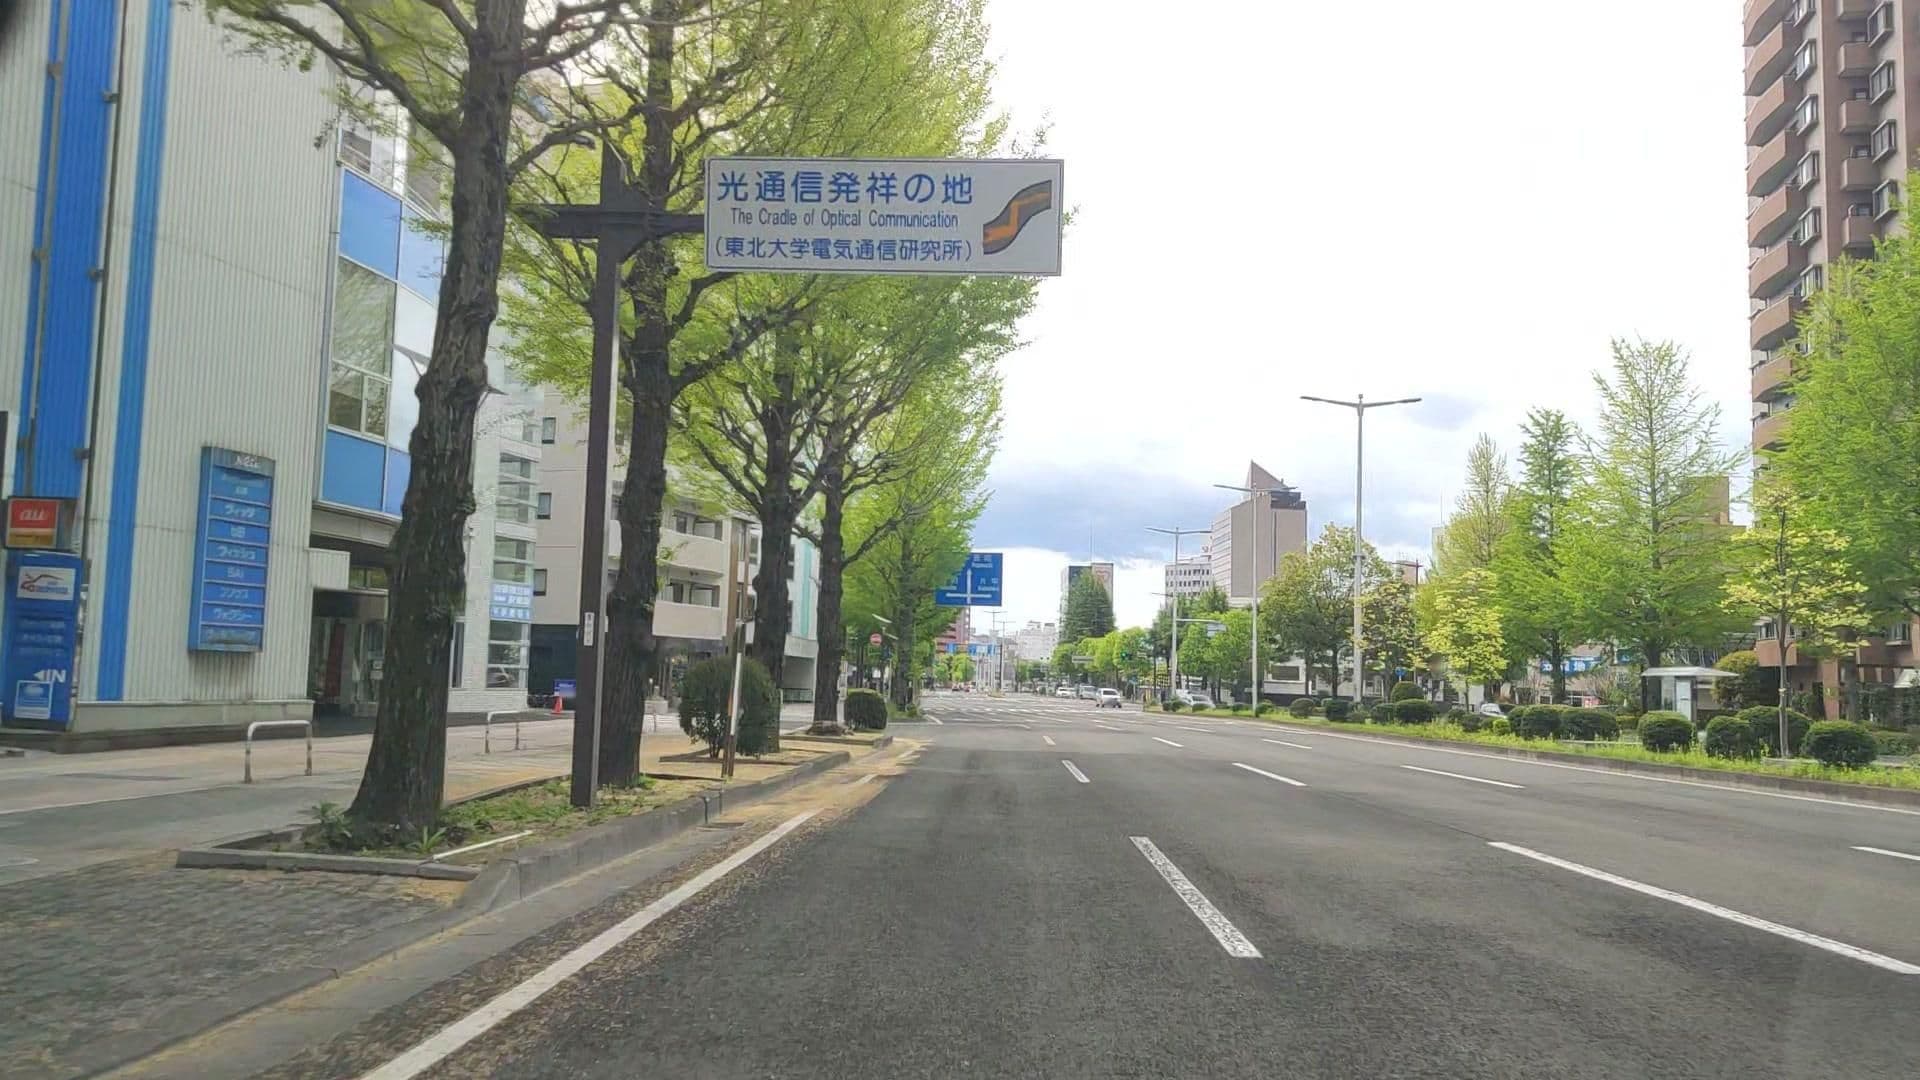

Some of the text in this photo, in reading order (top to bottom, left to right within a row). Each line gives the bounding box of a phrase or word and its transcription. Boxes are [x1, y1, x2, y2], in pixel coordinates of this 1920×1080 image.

[717, 171, 973, 204] 光通信発祥の地
[731, 208, 959, 229] The Cradle of Optical Communication
[47, 669, 67, 684] IN
